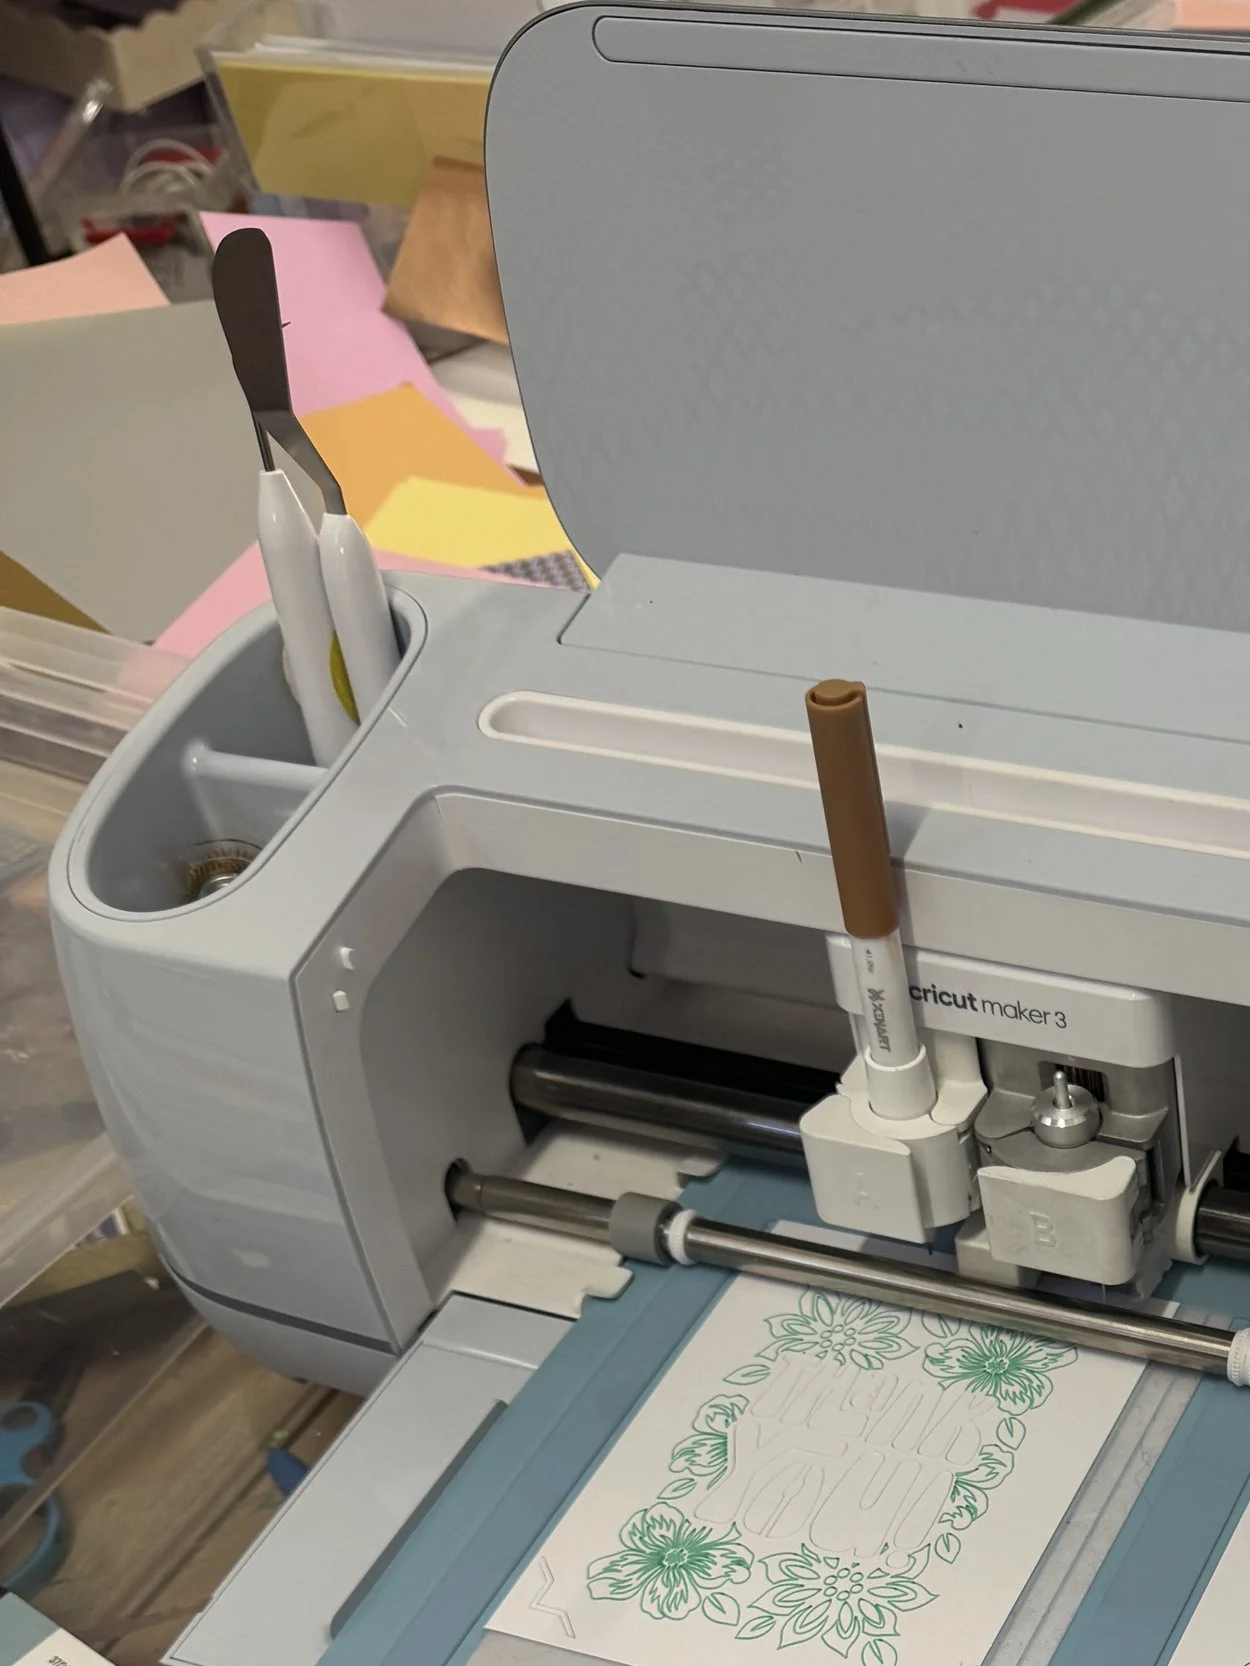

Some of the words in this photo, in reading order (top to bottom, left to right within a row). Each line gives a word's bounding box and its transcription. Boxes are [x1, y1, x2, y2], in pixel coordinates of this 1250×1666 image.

[908, 984, 979, 1013] cricut
[981, 1000, 1051, 1026] maker
[1054, 1011, 1068, 1030] 3
[1029, 1210, 1058, 1249] B
